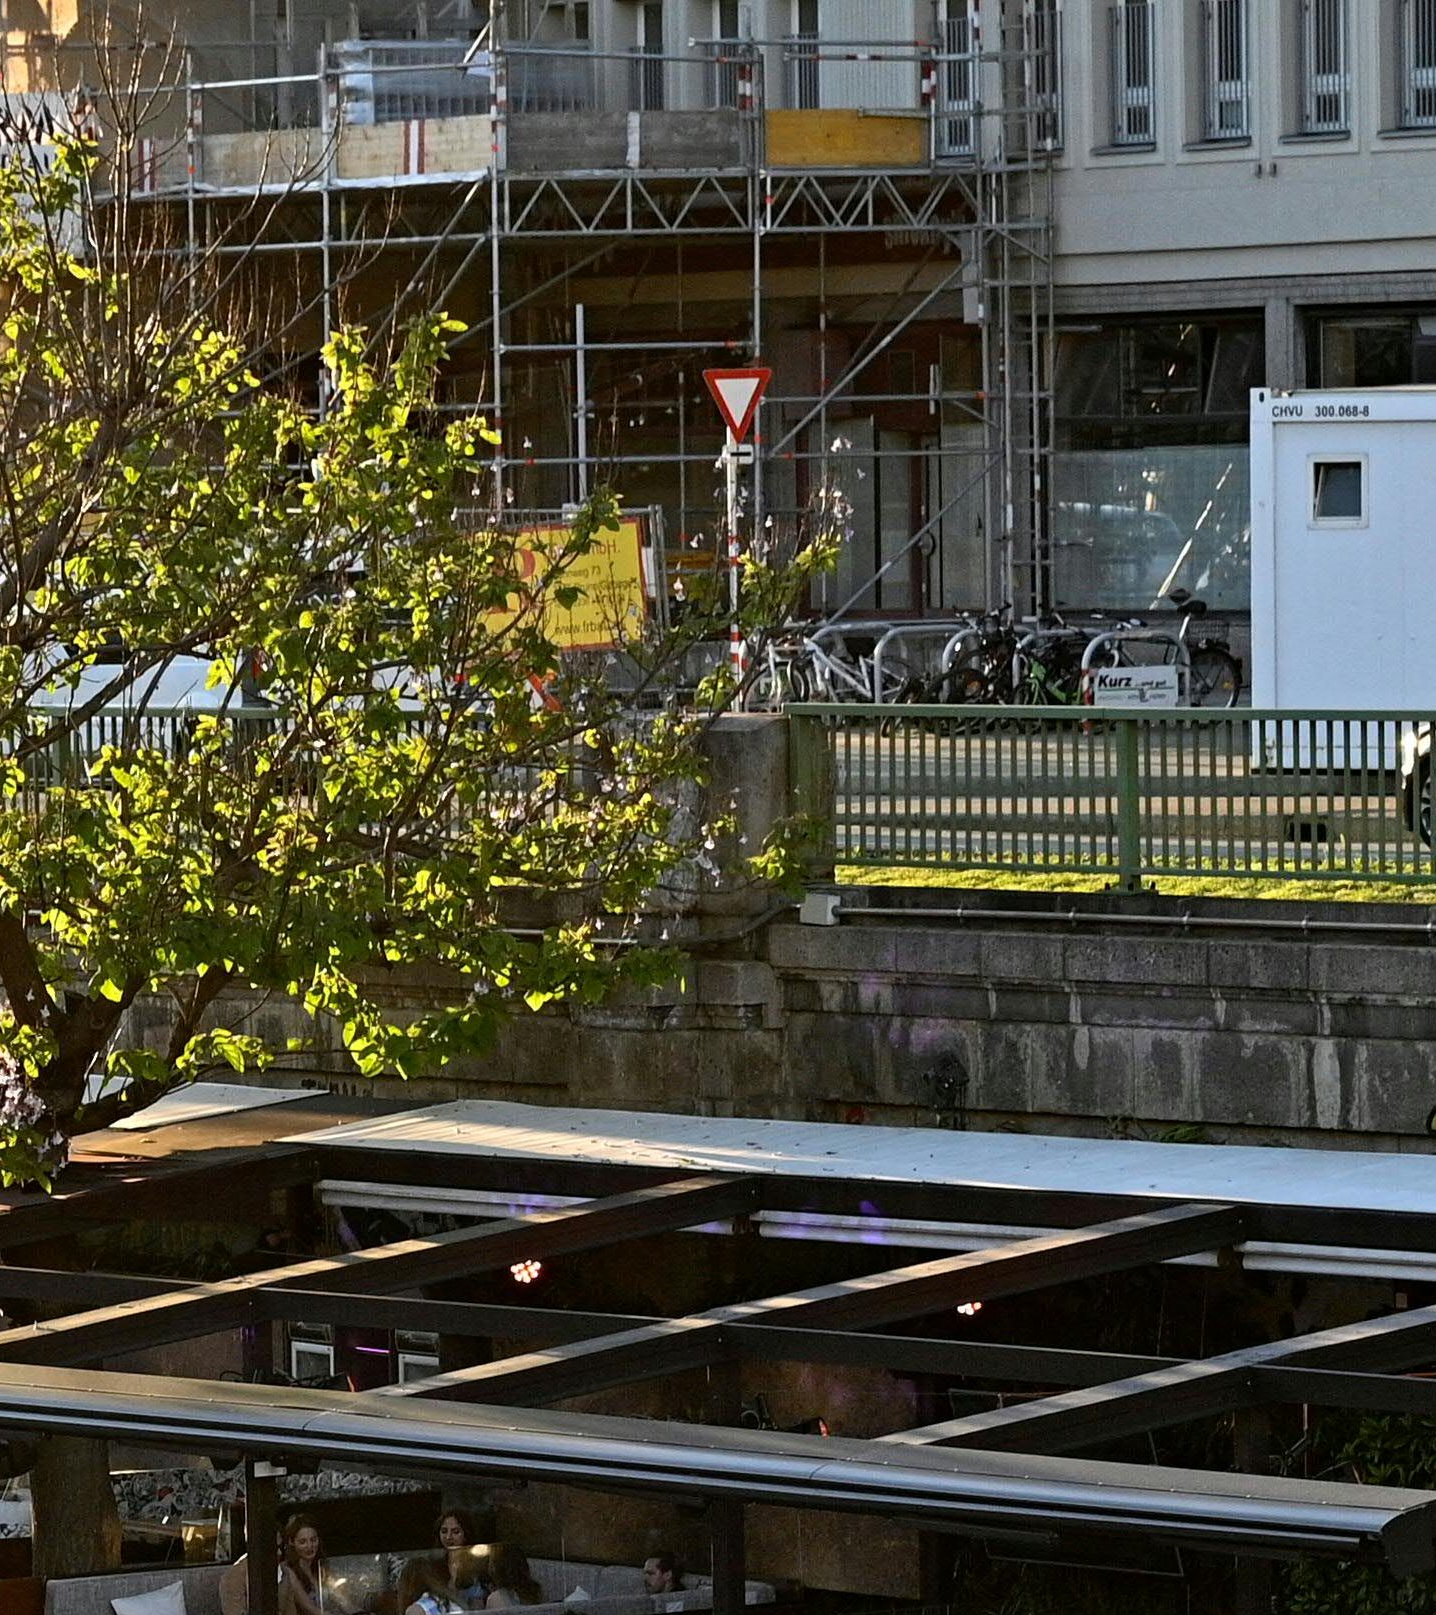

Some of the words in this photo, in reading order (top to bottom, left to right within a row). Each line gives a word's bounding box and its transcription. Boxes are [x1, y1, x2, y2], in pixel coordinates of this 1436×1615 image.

[1272, 405, 1303, 418] CHVU
[1315, 405, 1370, 418] 300.068-8
[1098, 674, 1132, 688] Kurz
